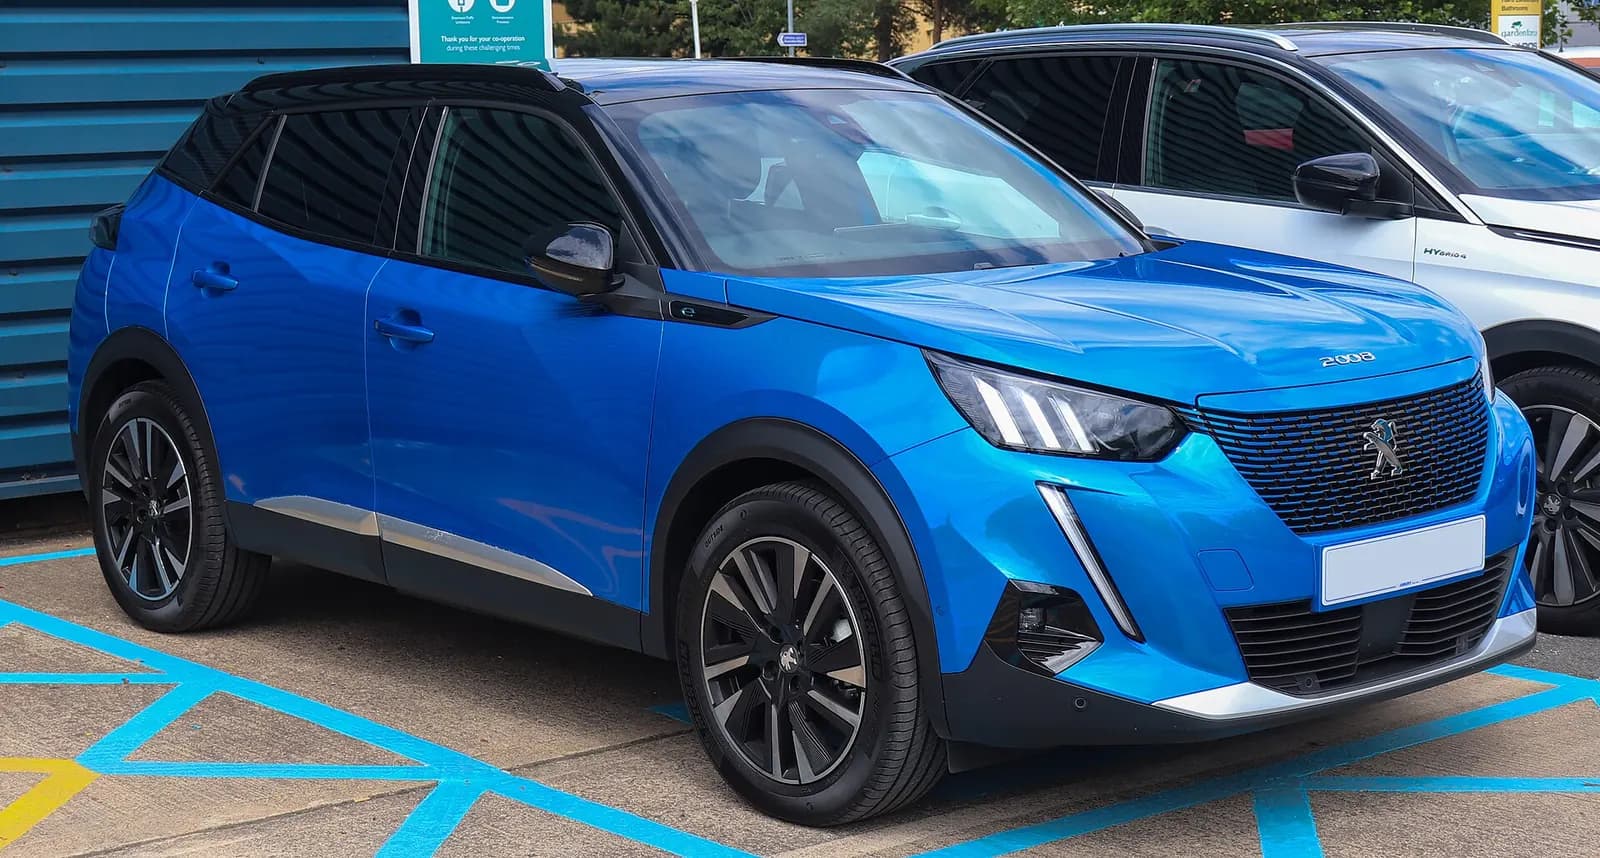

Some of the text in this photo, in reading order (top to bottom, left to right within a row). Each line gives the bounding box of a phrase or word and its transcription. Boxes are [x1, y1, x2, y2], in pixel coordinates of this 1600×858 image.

[492, 35, 526, 43] co-operation
[479, 44, 506, 52] challenging
[1319, 351, 1376, 367] 2008
